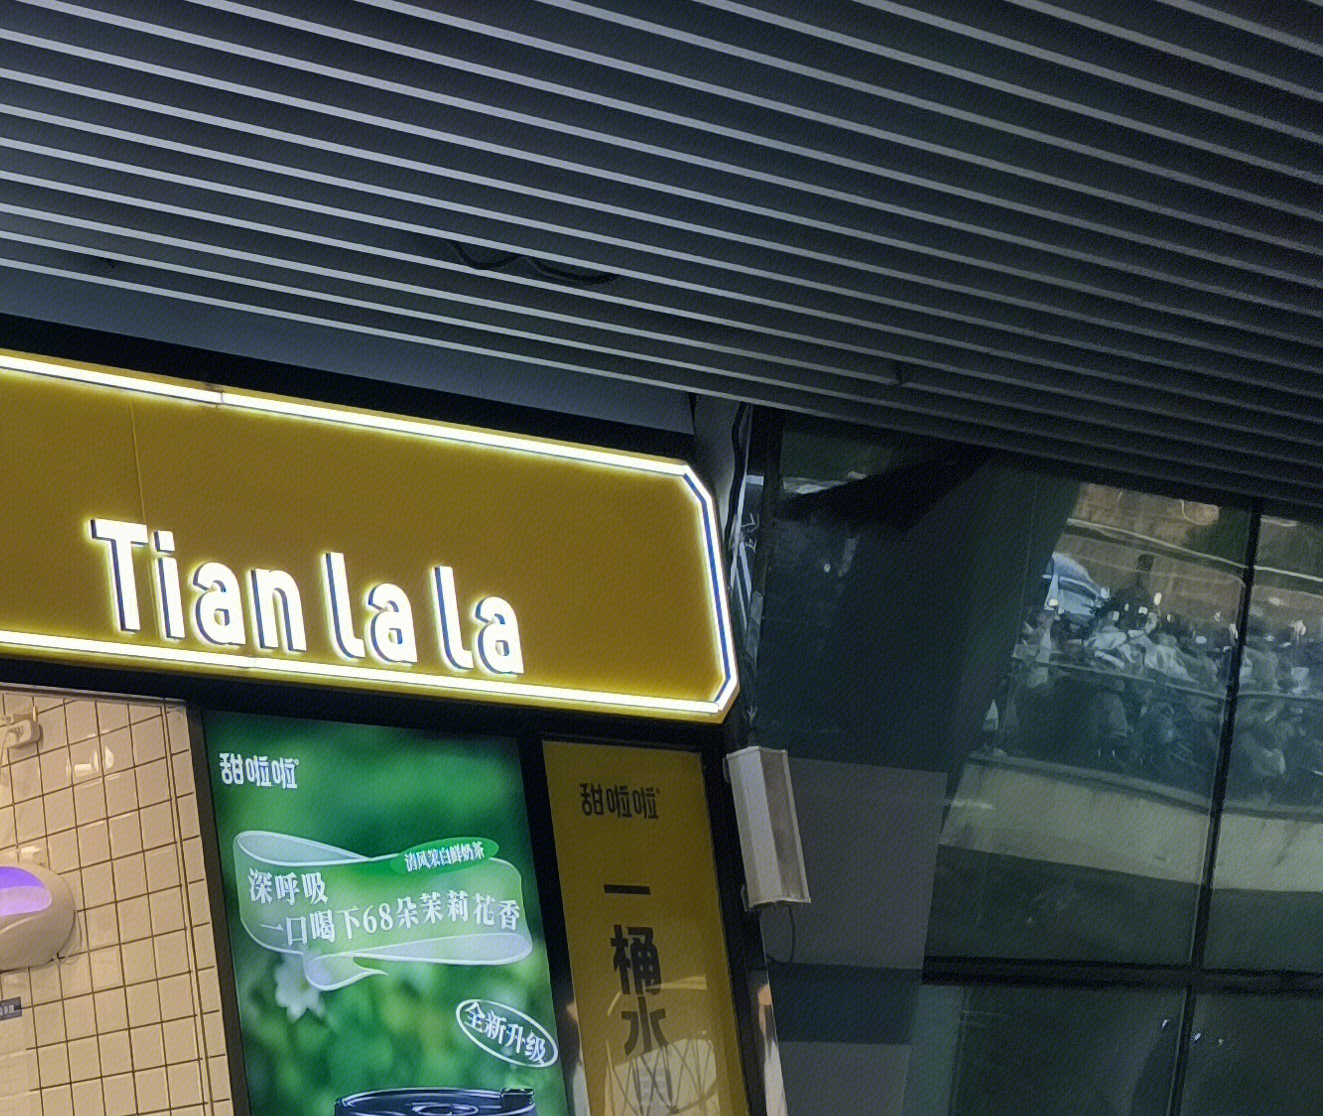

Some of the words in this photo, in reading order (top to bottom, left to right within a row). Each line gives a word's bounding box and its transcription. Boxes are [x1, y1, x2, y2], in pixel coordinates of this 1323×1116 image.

[89, 517, 307, 653] Tian
[323, 551, 418, 665] la
[434, 565, 525, 676] la
[219, 752, 298, 790] 甜啦啦
[579, 782, 659, 820] 甜啦啦
[247, 868, 329, 905] 深呼吸
[258, 889, 521, 946] 一口喝下68朵茉莉花香
[463, 1001, 548, 1065] 全新升级
